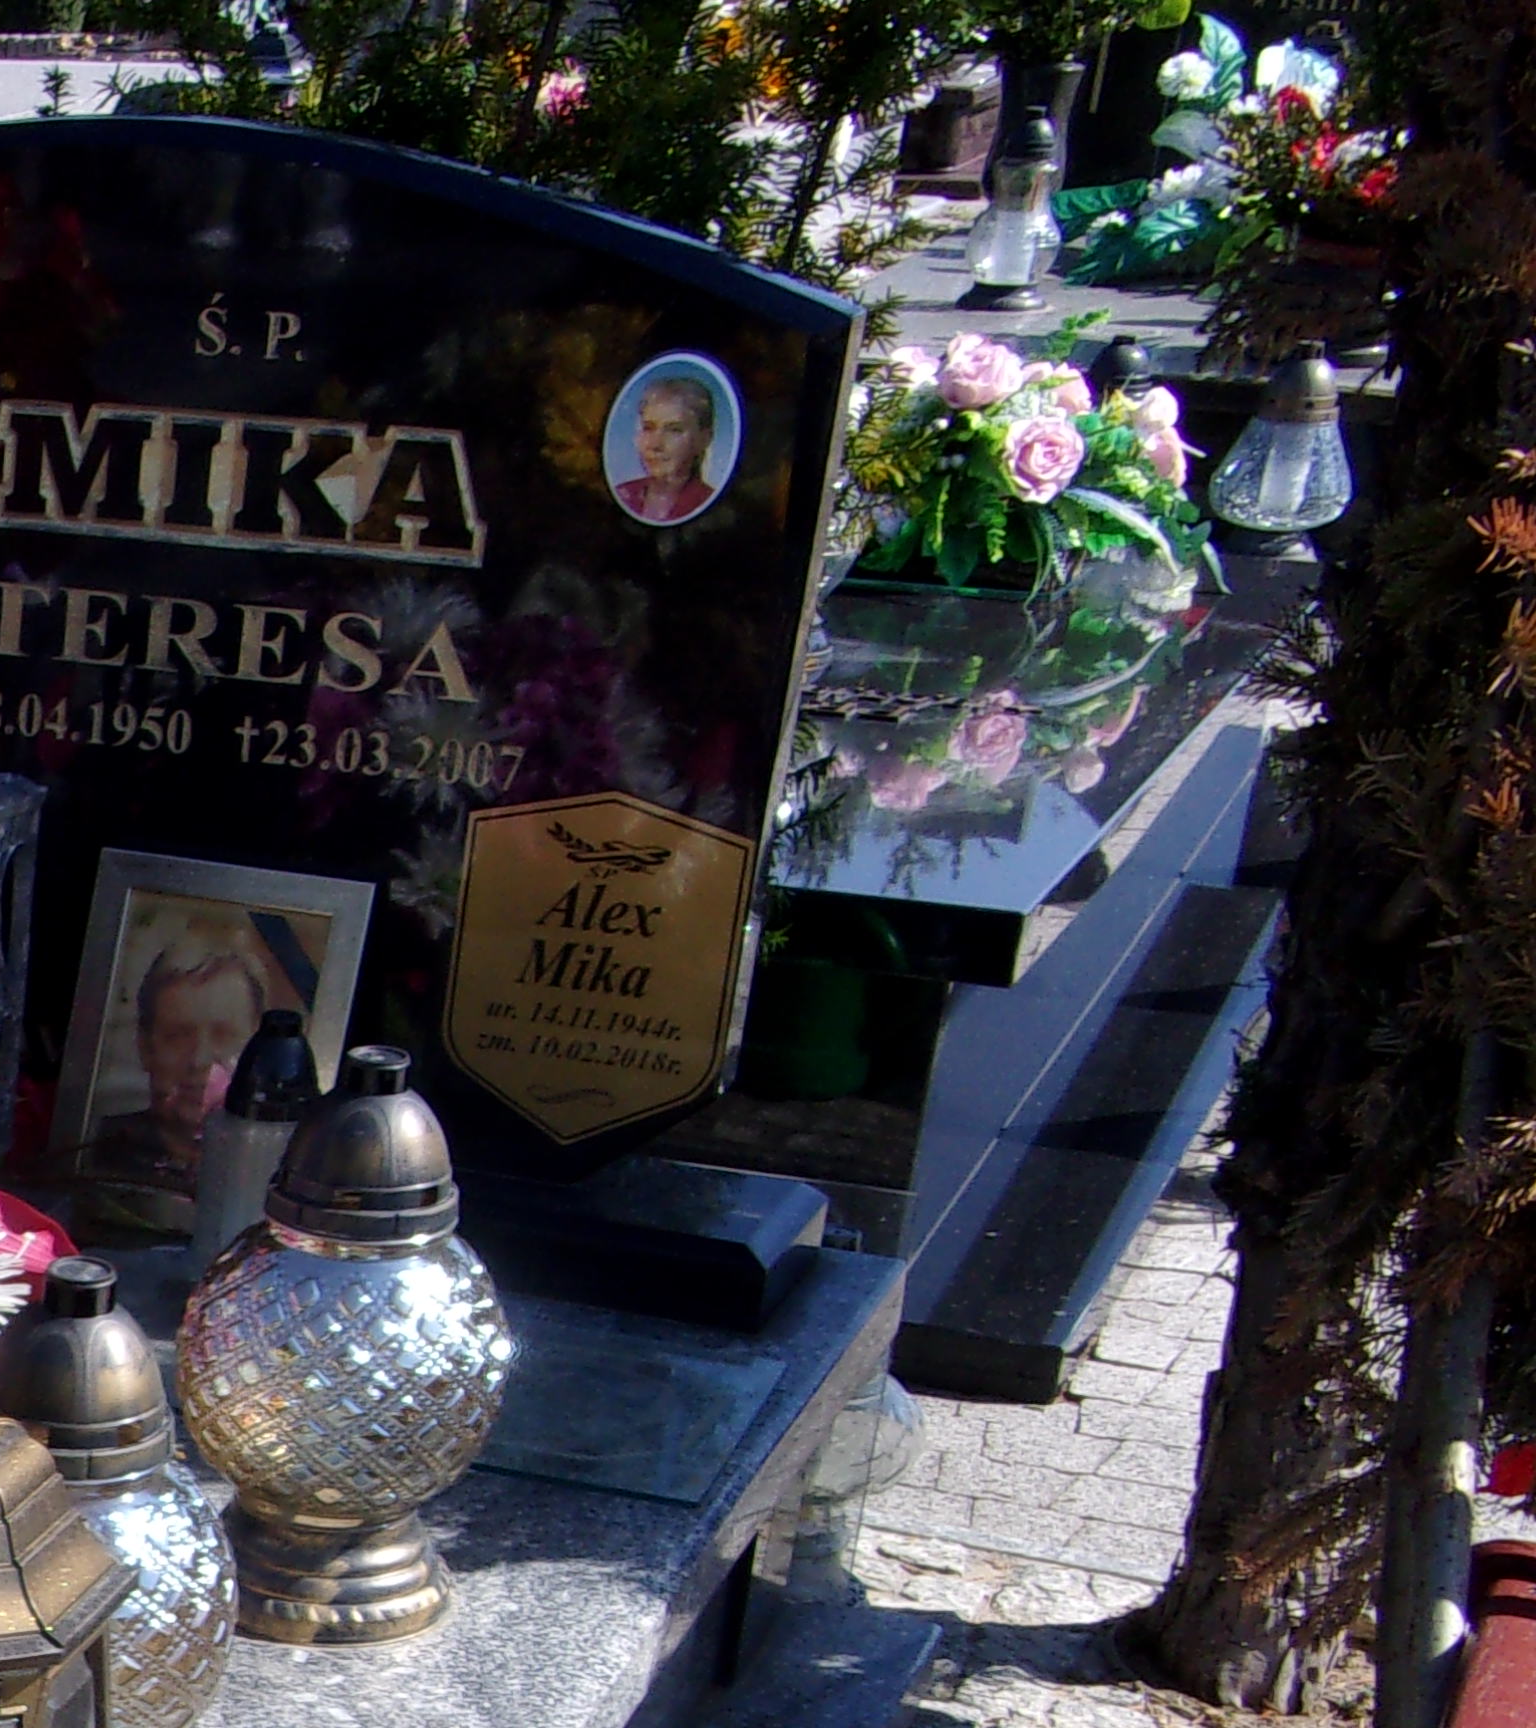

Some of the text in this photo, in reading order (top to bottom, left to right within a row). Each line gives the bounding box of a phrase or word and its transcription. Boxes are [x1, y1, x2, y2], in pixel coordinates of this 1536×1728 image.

[194, 292, 306, 362] Ś. P.
[536, 882, 662, 938] Alex
[516, 938, 652, 999] Mika
